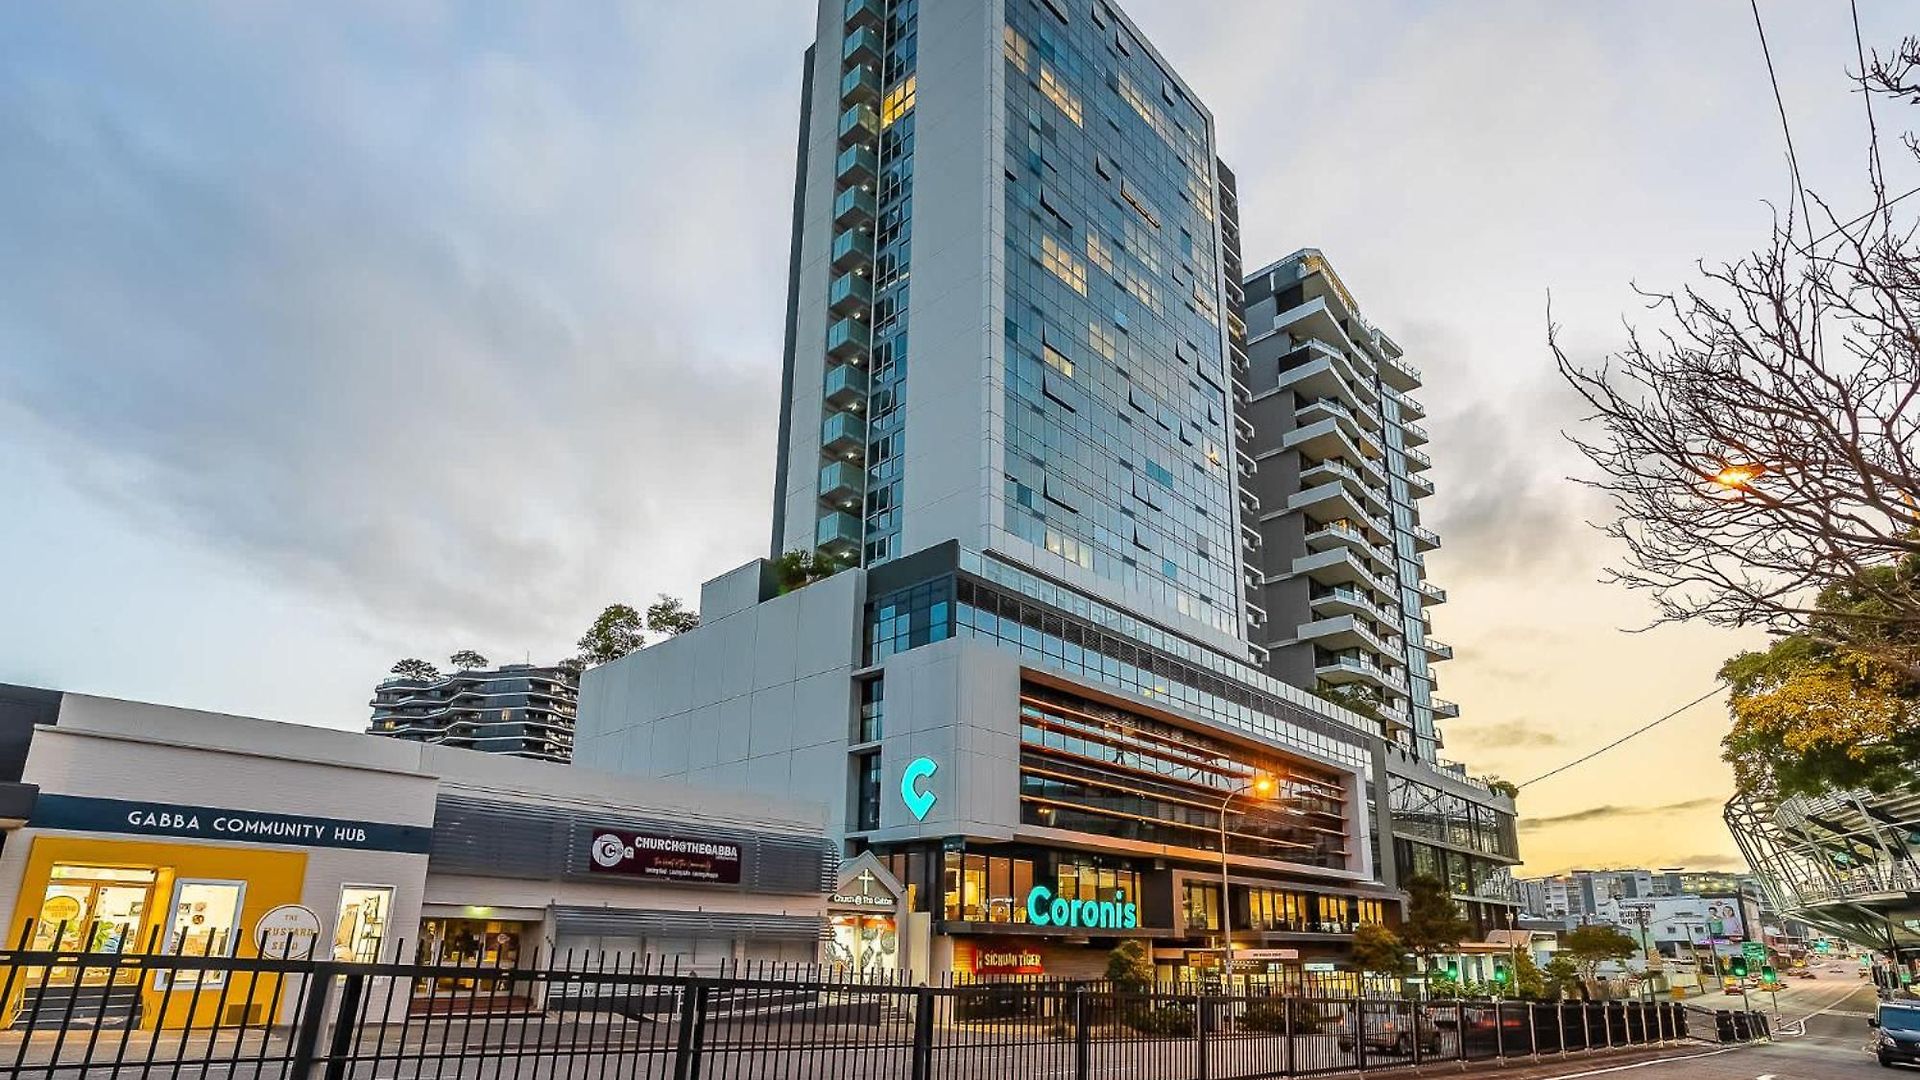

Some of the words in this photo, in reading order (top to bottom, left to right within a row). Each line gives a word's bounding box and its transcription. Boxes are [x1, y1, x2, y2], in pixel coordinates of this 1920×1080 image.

[127, 811, 199, 829] GABBA
[213, 817, 324, 838] COMMUNITY
[334, 827, 366, 841] HUB
[635, 836, 738, 857] CHURCH@THEGABBA
[1027, 885, 1136, 928] Coronis
[271, 941, 298, 950] SED
[1019, 949, 1042, 967] TIGER
